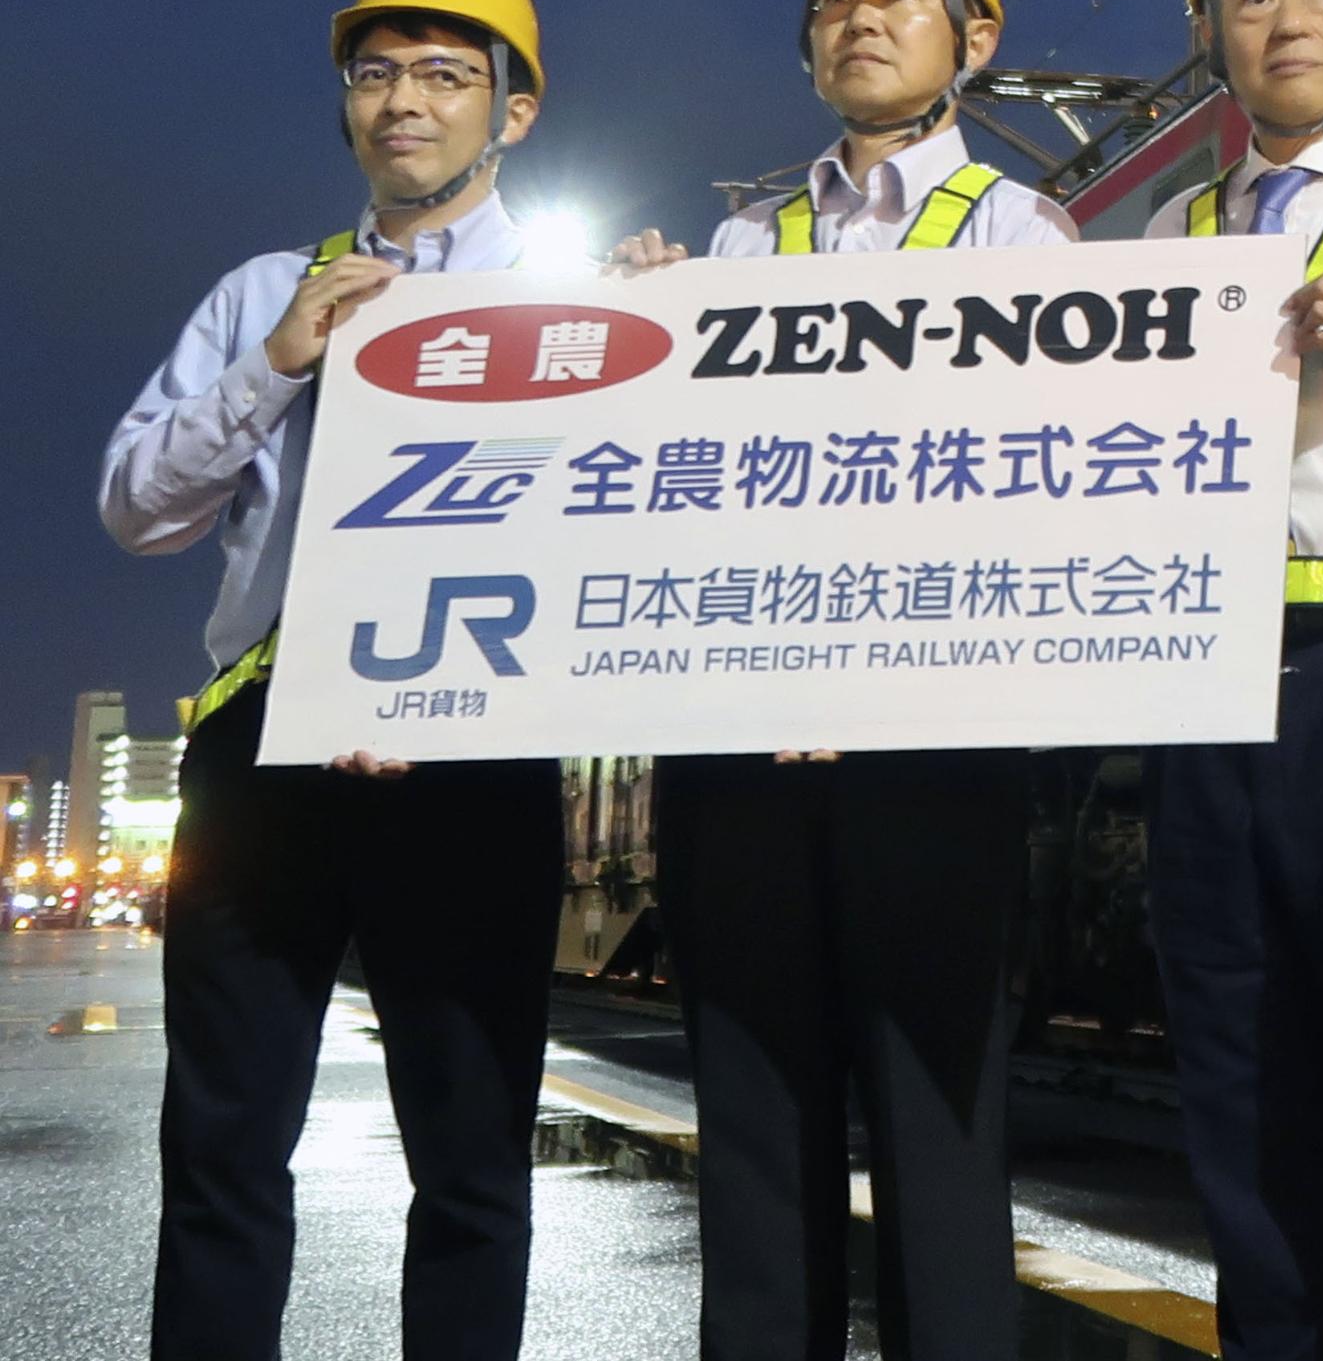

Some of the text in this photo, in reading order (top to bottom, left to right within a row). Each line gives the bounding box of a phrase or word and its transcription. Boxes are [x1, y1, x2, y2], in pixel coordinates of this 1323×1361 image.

[415, 320, 611, 387] 全農
[690, 287, 1201, 379] ZEN-NOH
[562, 418, 1252, 516] 全農物流株式会社
[349, 574, 536, 682] JR
[571, 634, 1217, 676] JAPAN FREIGHT RAILWAY COMPANY
[376, 688, 487, 720] JR貨物
